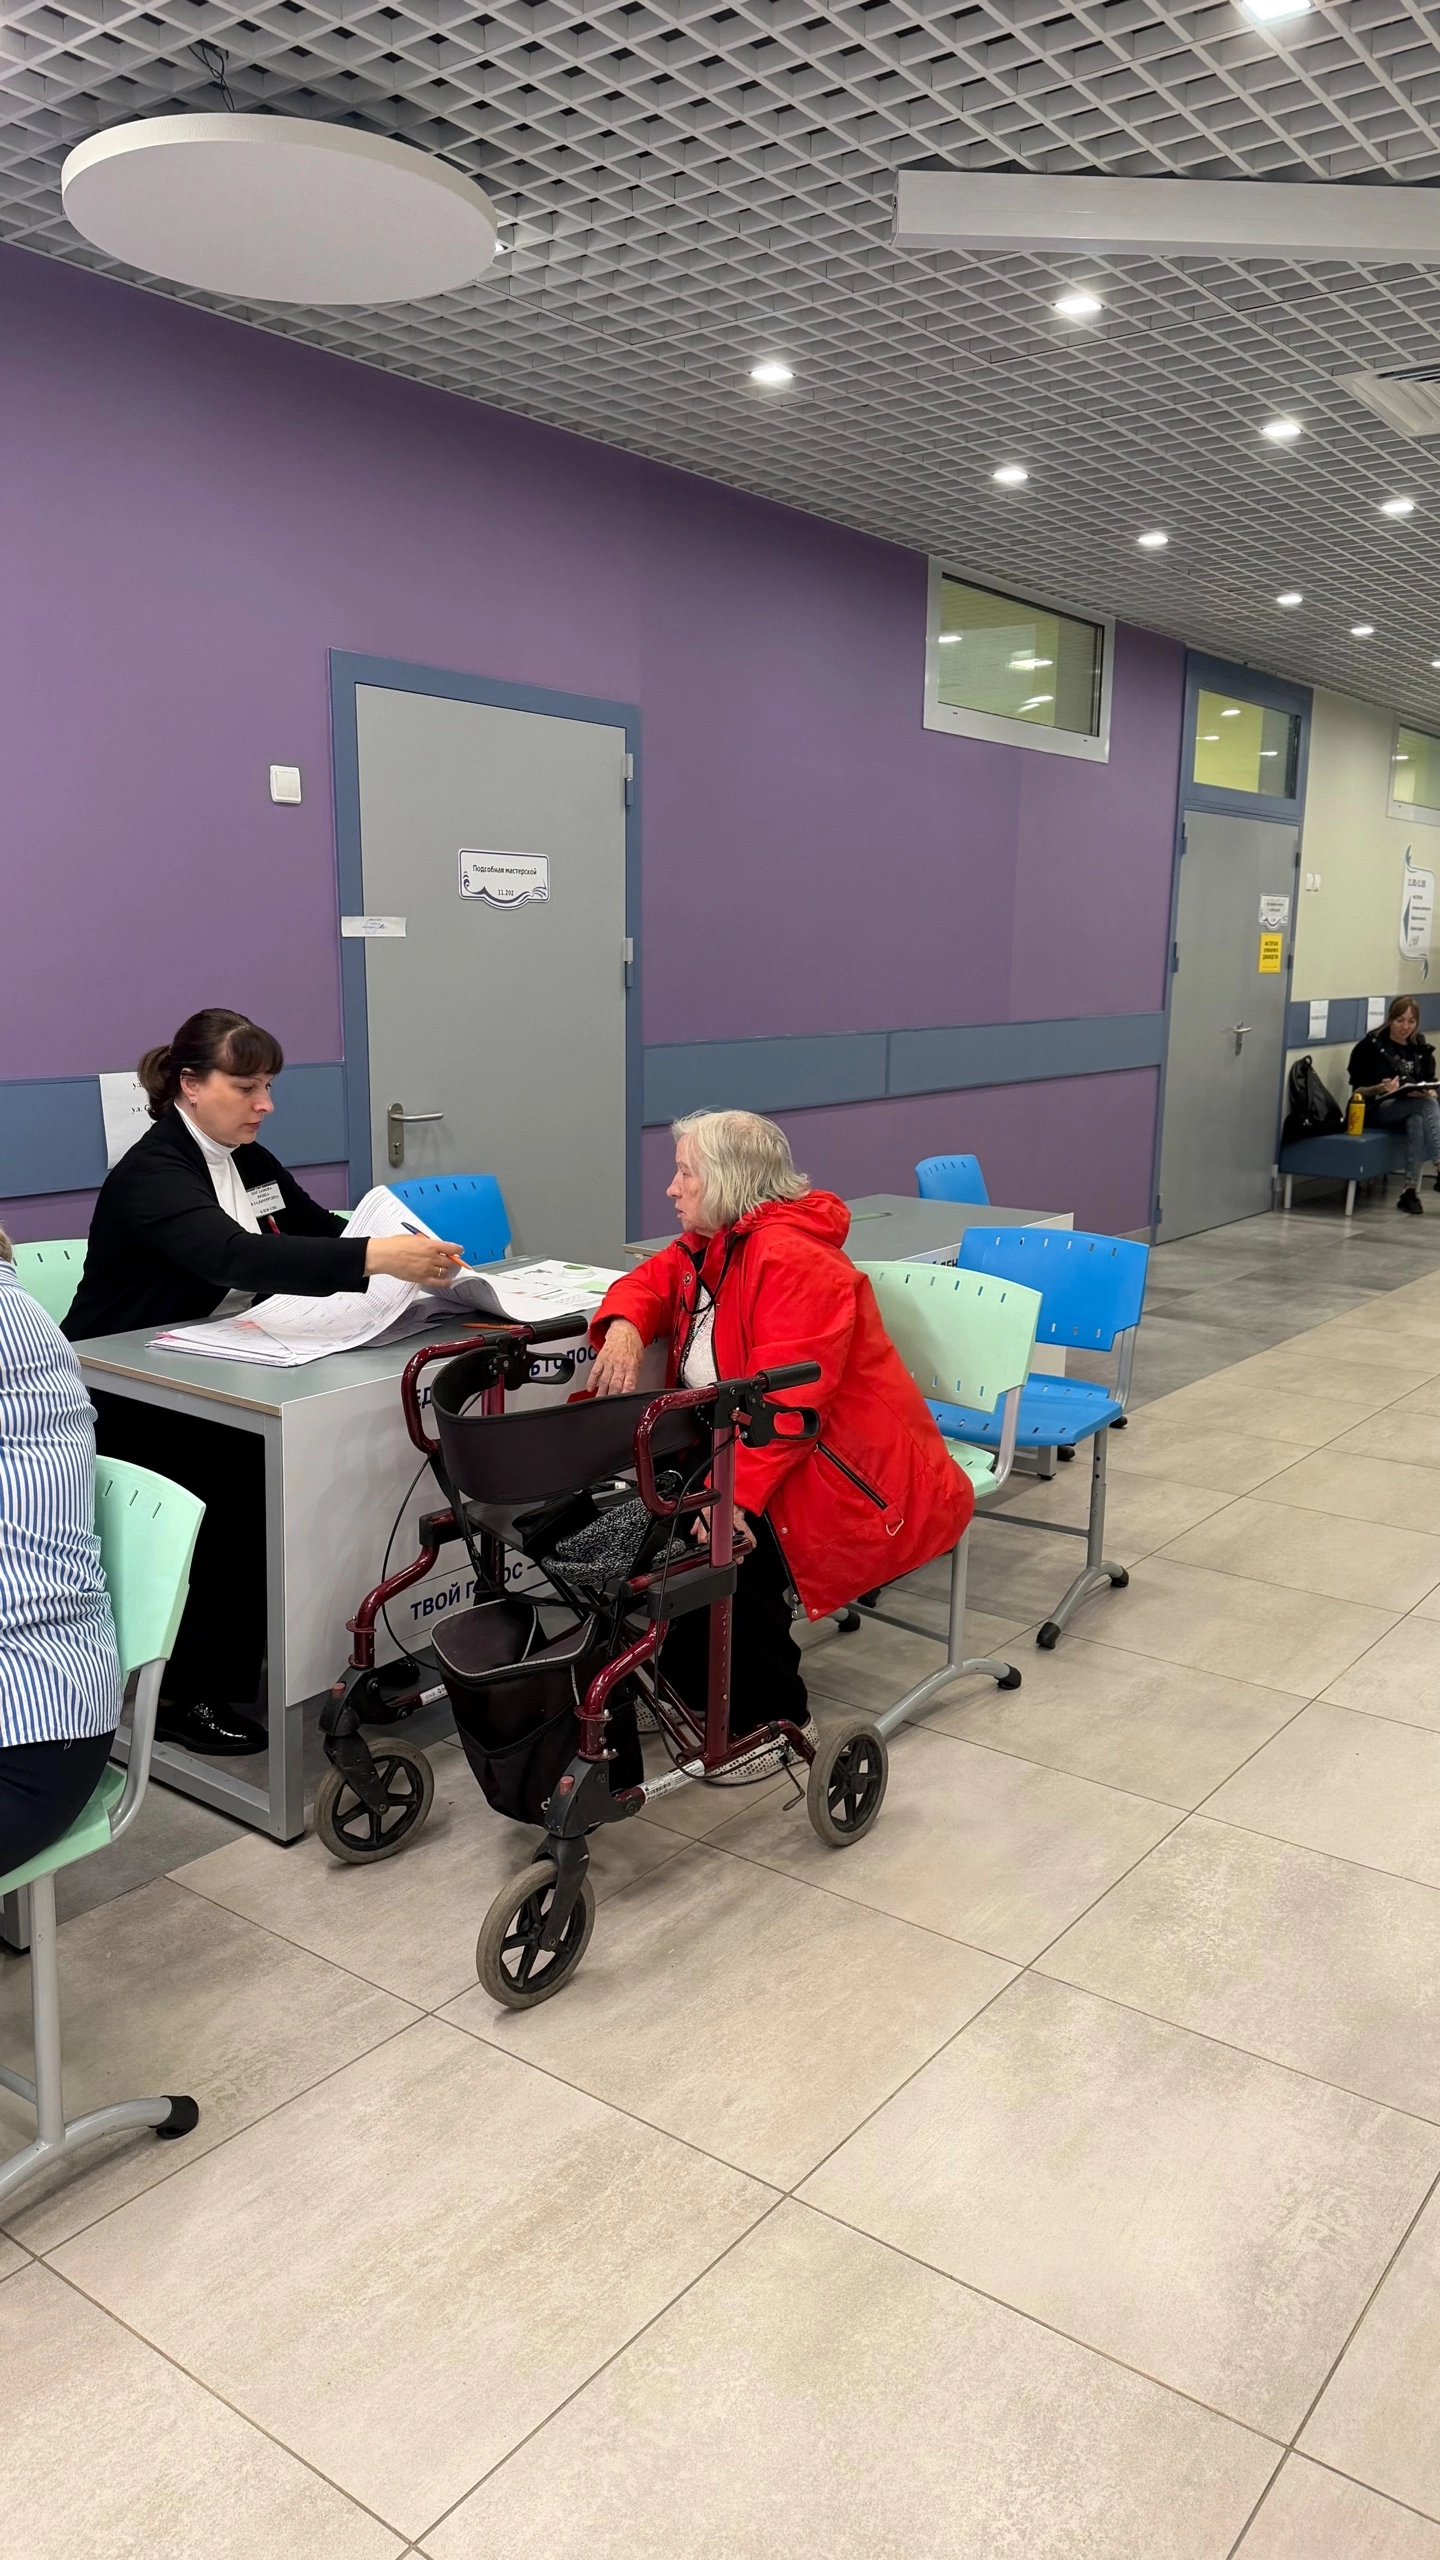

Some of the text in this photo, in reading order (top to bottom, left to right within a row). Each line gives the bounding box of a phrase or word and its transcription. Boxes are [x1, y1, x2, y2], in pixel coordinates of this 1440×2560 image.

[472, 864, 537, 876] Подсобная мастерской
[410, 1581, 460, 1620] ТВОЙ
